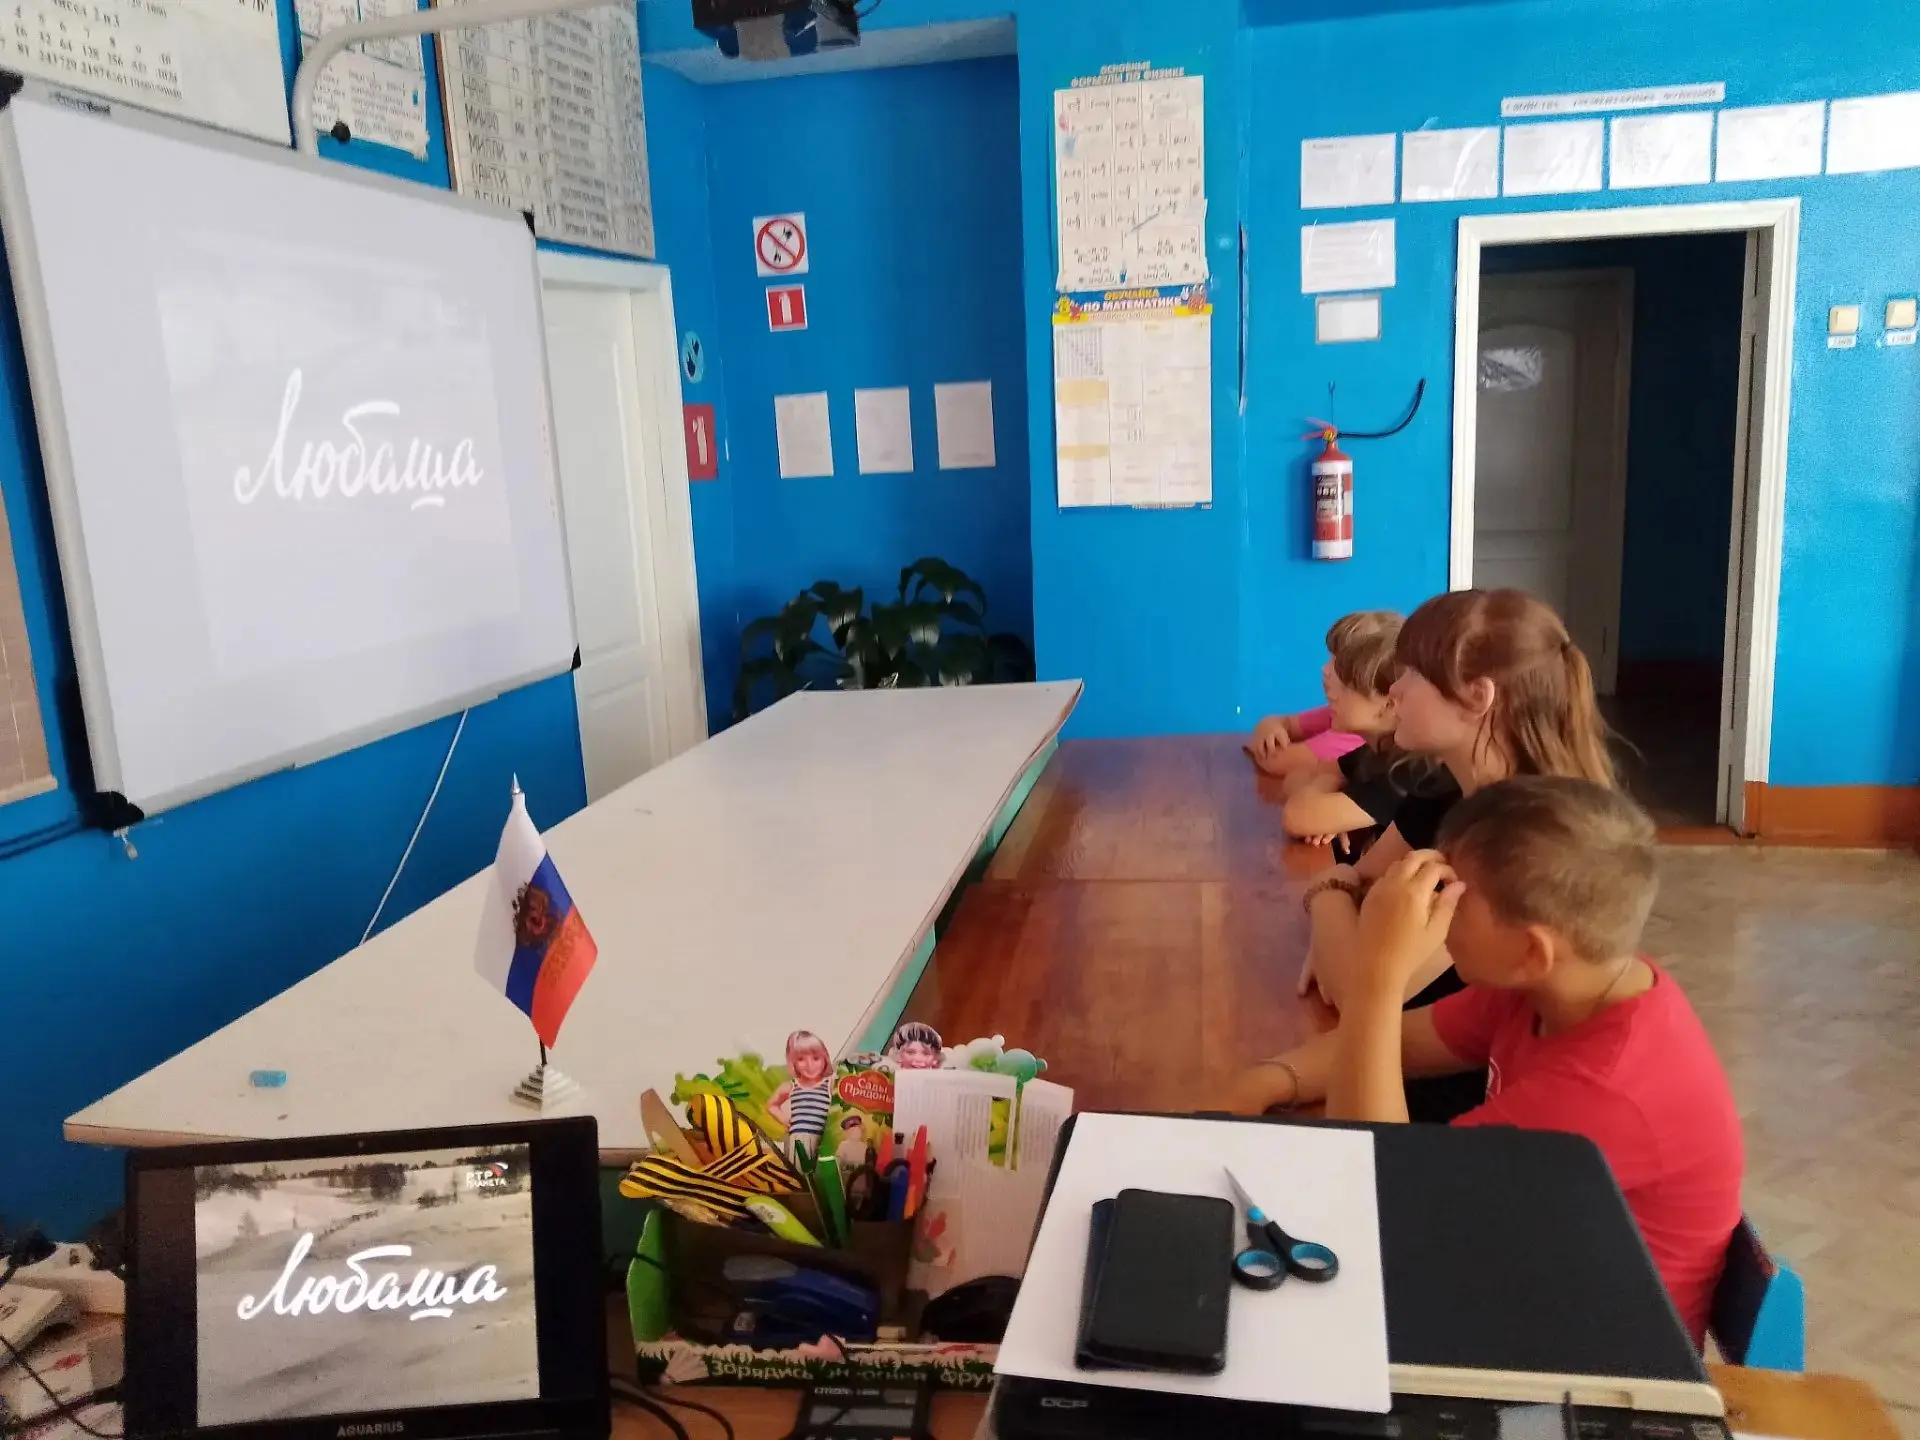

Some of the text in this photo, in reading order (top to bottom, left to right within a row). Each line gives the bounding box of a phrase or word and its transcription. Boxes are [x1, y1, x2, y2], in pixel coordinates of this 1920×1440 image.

[1083, 296, 1181, 313] ПО МАТЕМАТИКЕ
[233, 366, 485, 511] Любаша
[844, 1082, 894, 1103] Придонь
[858, 1077, 888, 1094] Сады
[237, 1231, 508, 1321] Любаша
[337, 1420, 405, 1438] AQUARIUS
